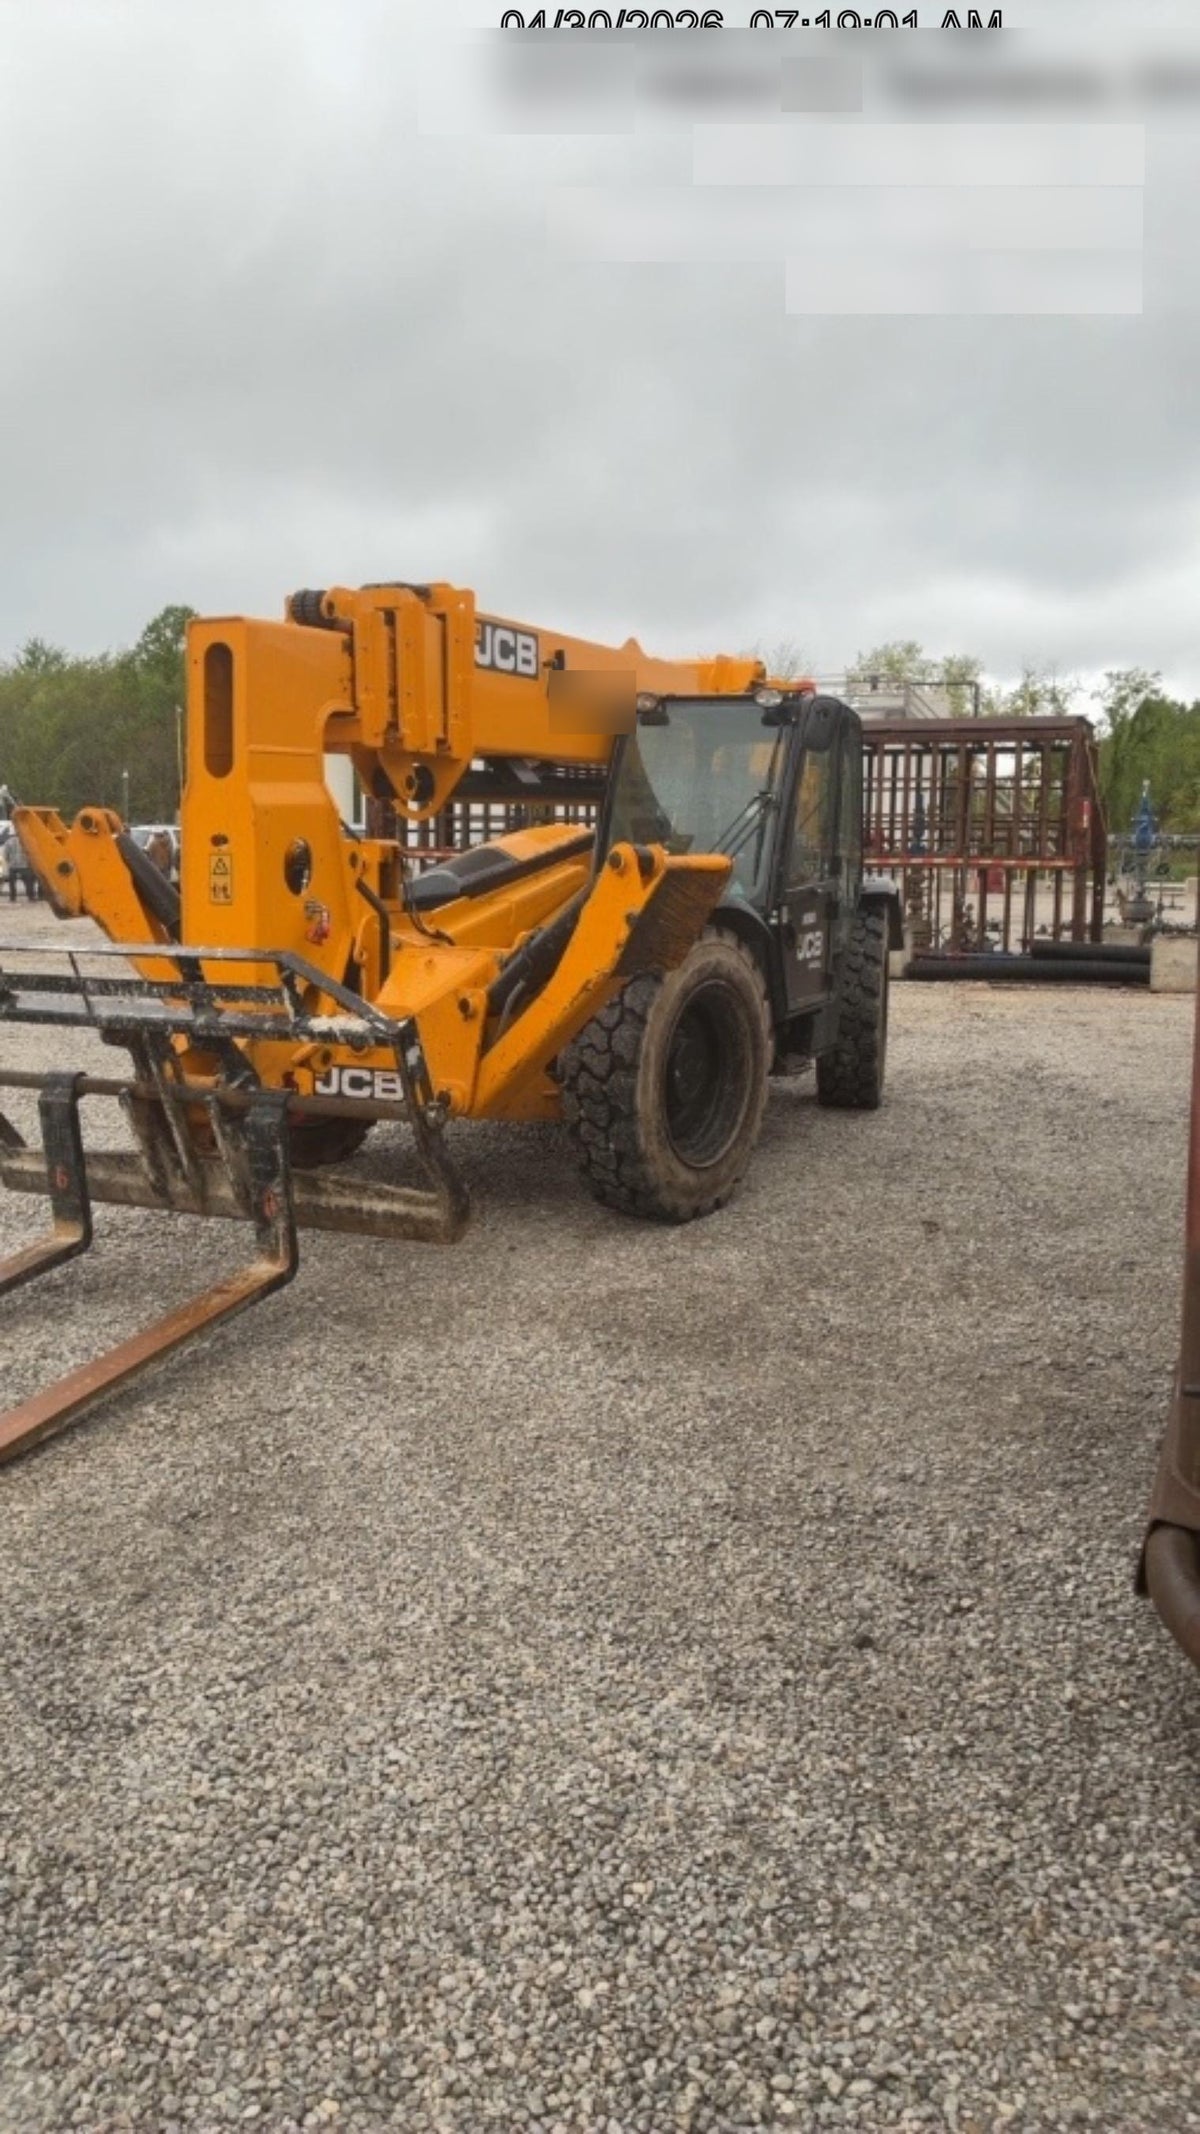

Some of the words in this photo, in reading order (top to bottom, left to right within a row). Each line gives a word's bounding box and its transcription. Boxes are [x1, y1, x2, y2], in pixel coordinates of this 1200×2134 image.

[474, 624, 537, 676] JCB
[797, 930, 823, 960] JCB
[314, 1066, 404, 1100] JCB
